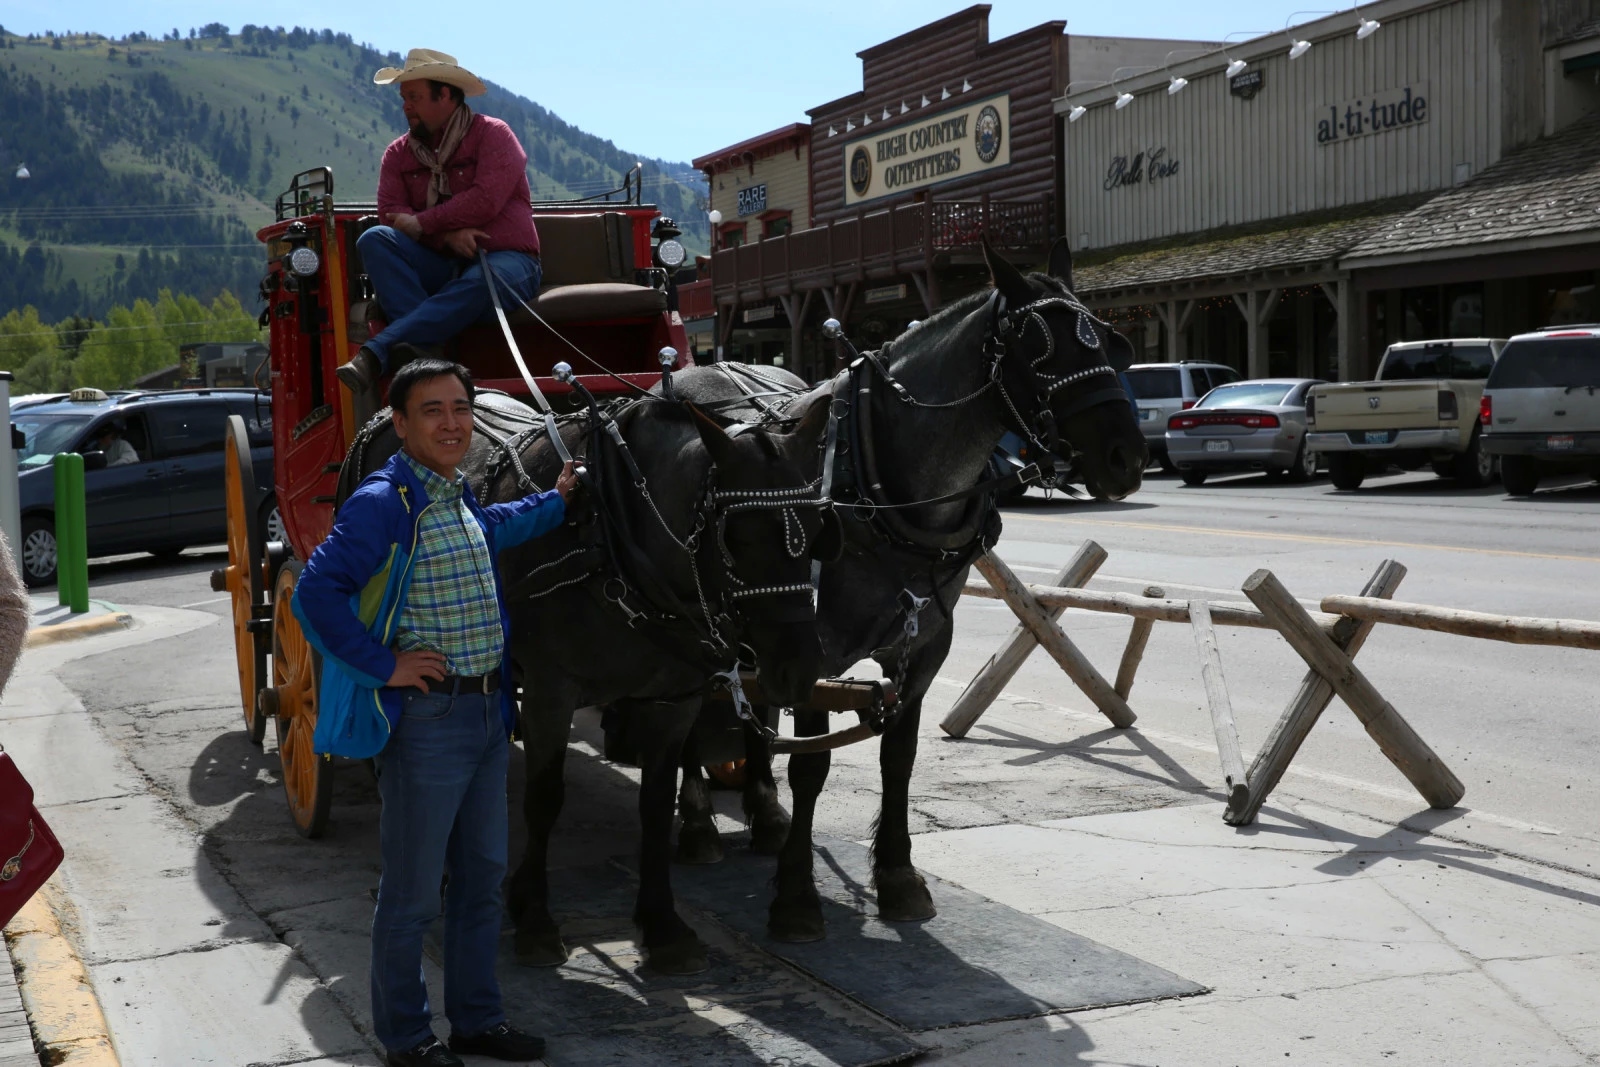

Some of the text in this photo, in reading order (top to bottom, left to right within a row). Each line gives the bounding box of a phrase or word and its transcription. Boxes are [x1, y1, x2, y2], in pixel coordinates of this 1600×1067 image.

[876, 132, 908, 163] HIGH
[909, 113, 969, 153] COUNTRY
[884, 147, 961, 189] OUTFITTERS
[737, 184, 767, 207] RARE
[737, 200, 766, 217] GALLERY
